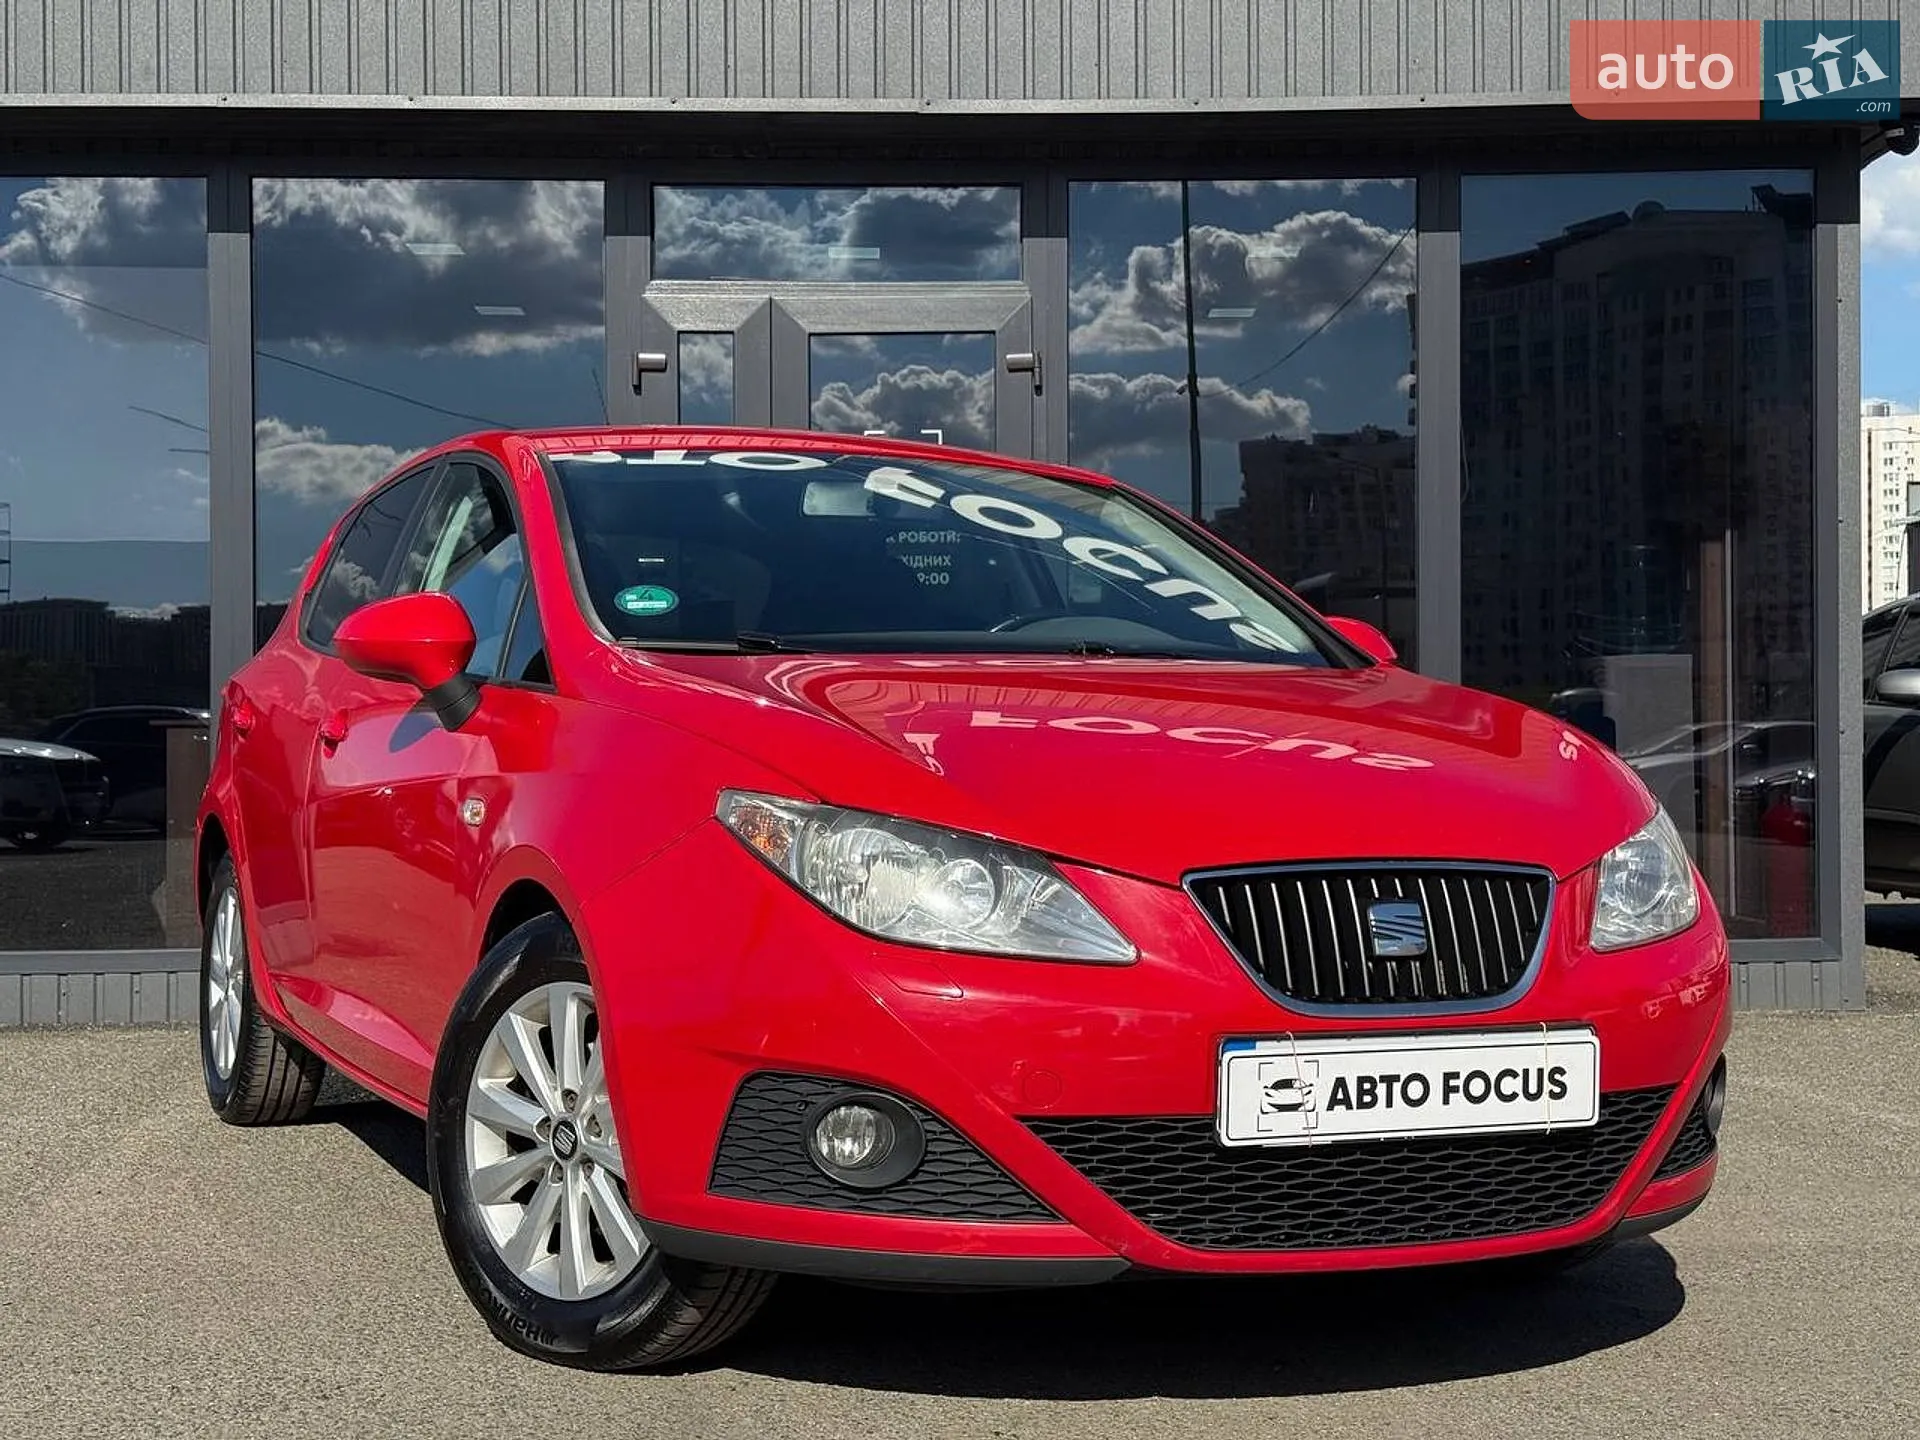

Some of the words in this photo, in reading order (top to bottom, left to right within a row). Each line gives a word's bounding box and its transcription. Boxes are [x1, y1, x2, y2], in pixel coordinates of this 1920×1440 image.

[901, 554, 952, 568] ХІДНИХ
[1326, 1072, 1431, 1112] АВТО
[1442, 1065, 1568, 1106] FOCUS
